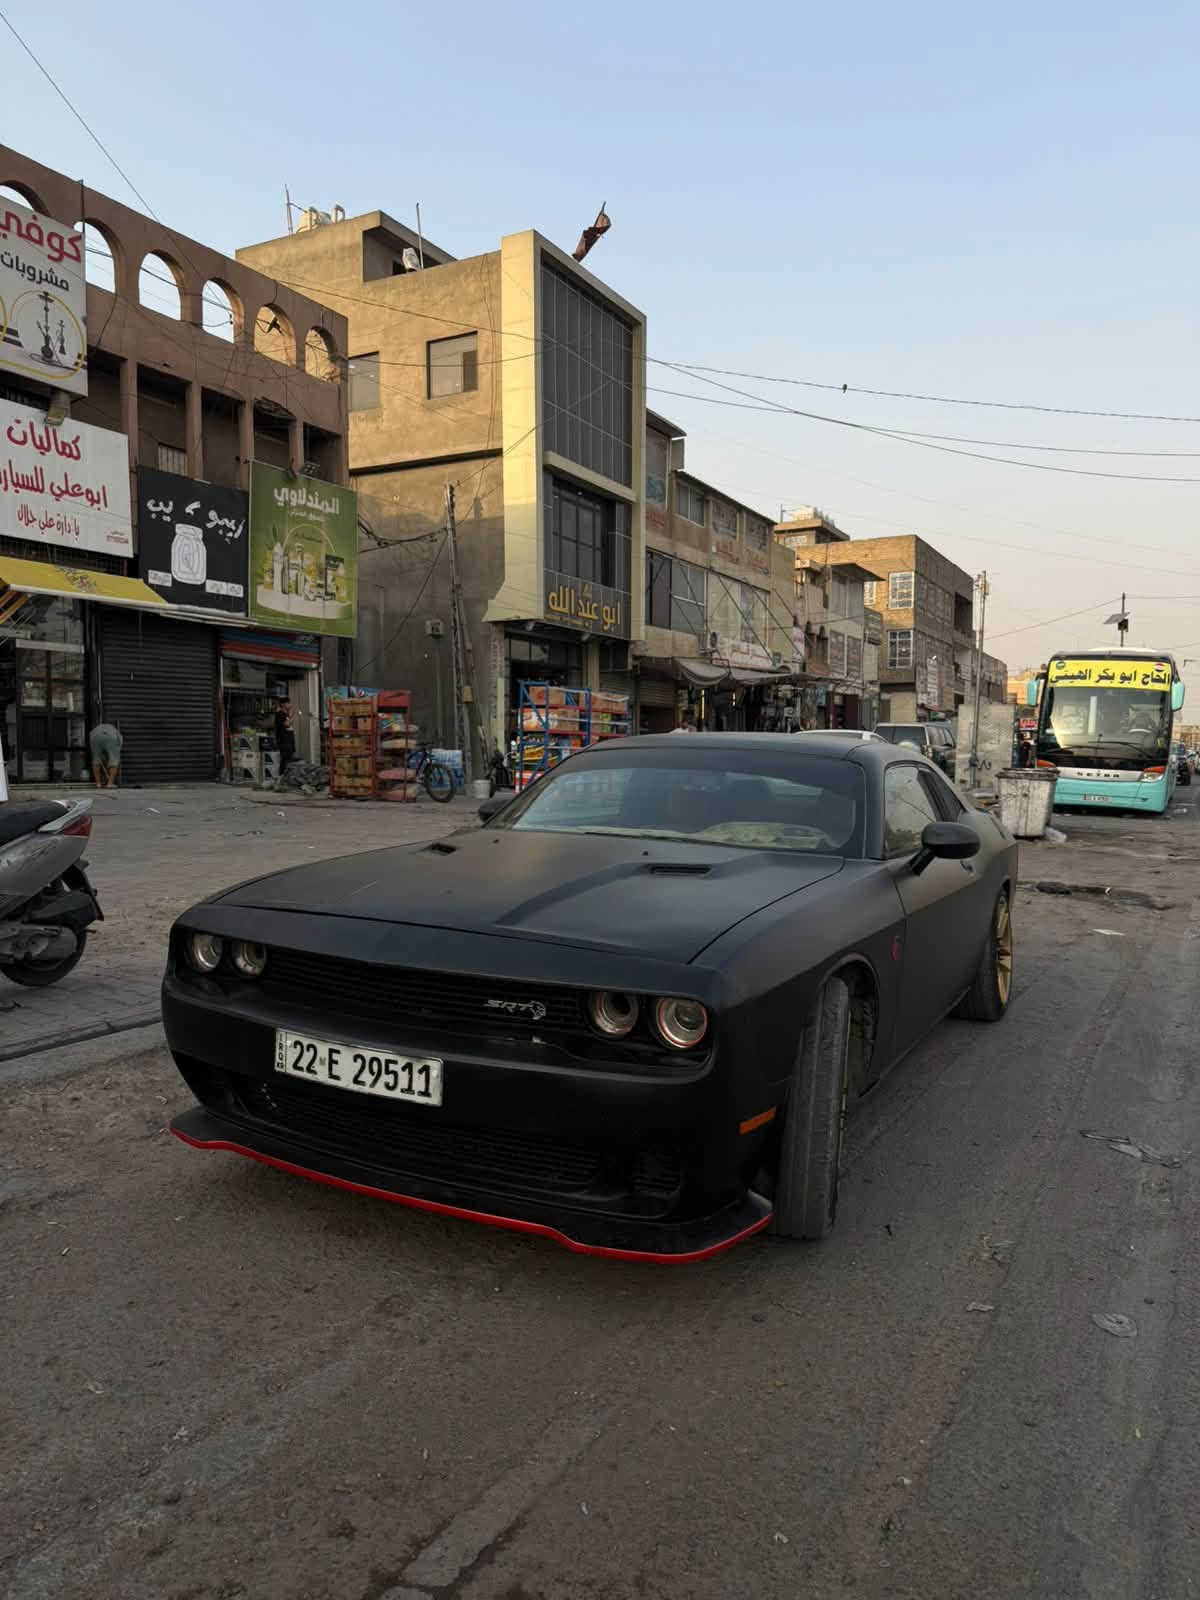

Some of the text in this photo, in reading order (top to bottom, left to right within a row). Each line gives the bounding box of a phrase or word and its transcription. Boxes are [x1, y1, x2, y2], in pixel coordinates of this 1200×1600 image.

[0, 251, 70, 291] مشروبات
[7, 418, 81, 461] كماليات
[0, 459, 45, 494] للسيار
[274, 487, 340, 515] المندلاوي
[38, 510, 55, 534] علي
[548, 586, 575, 614] الله
[603, 600, 620, 631] ابو
[1096, 669, 1115, 683] بكر
[1120, 670, 1136, 684] ابو
[1141, 672, 1170, 686] الحاج
[292, 1040, 432, 1098] 22 E 29511
